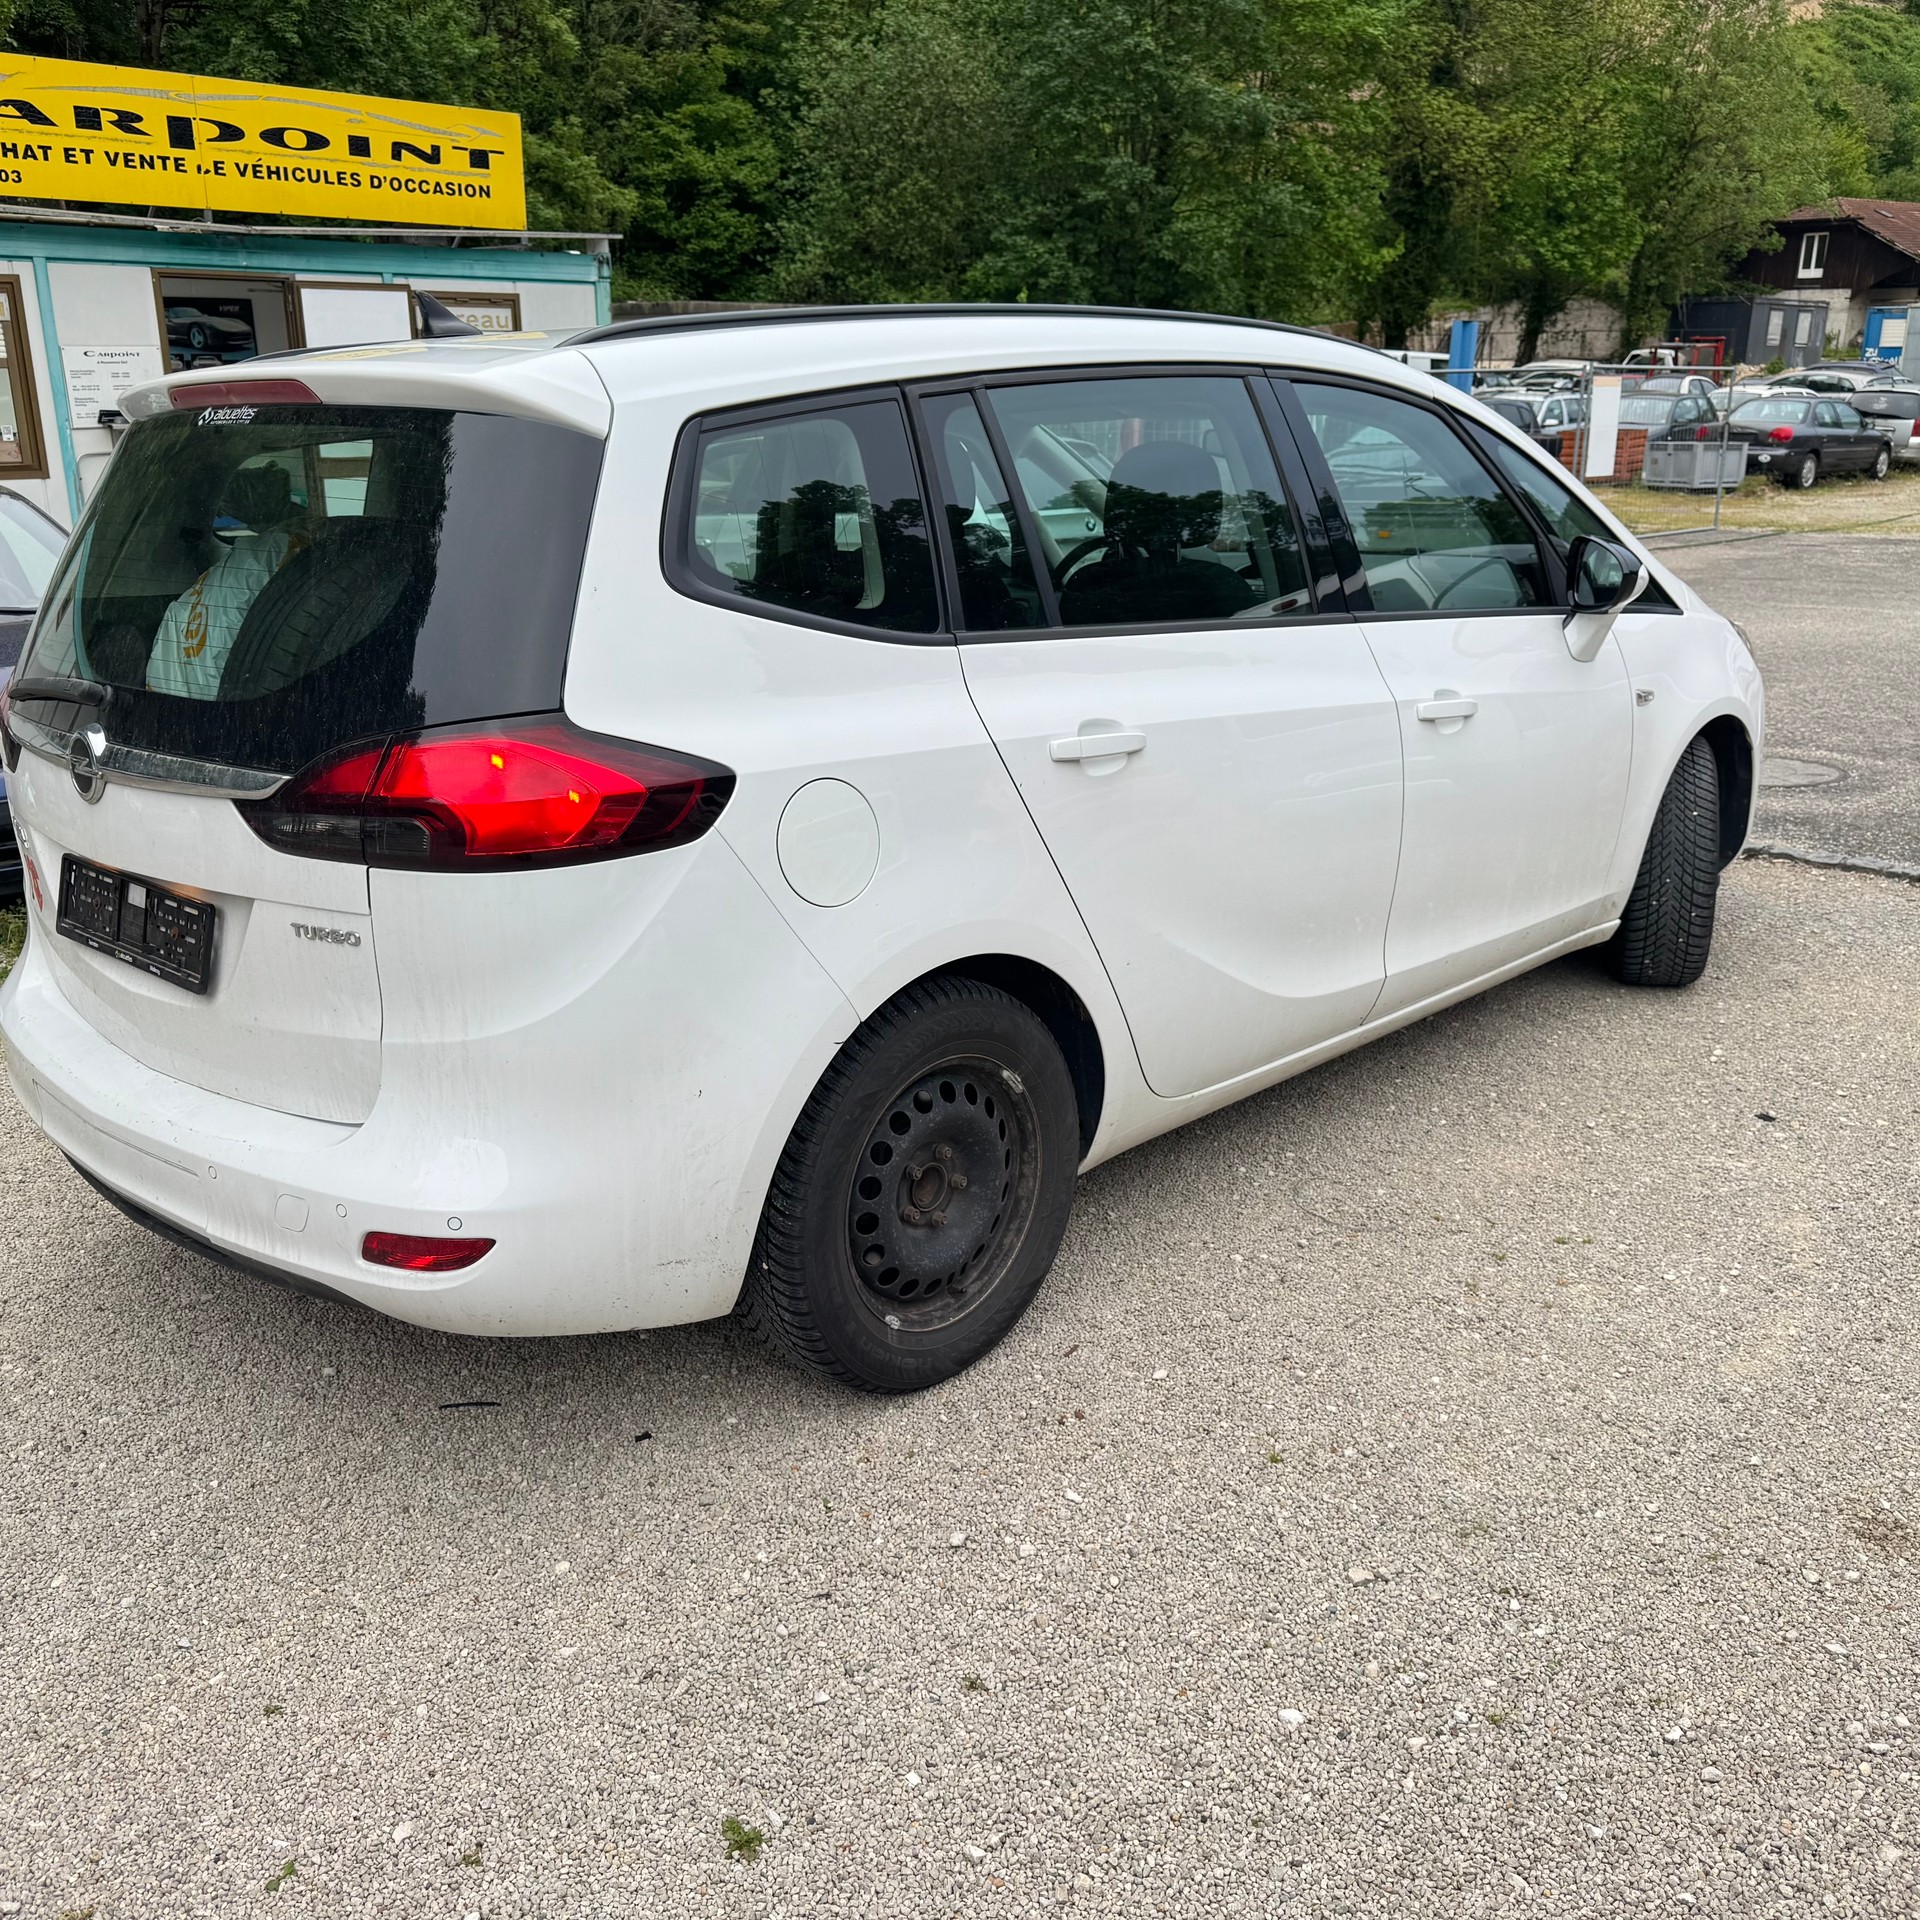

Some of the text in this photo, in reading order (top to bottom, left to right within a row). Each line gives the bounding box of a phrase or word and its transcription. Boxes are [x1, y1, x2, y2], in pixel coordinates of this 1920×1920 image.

[63, 147, 94, 165] ET
[104, 151, 188, 174] VENTE
[234, 158, 362, 188] VÉHICULES
[369, 174, 491, 199] D'OCCASION
[290, 922, 361, 946] TURBO
